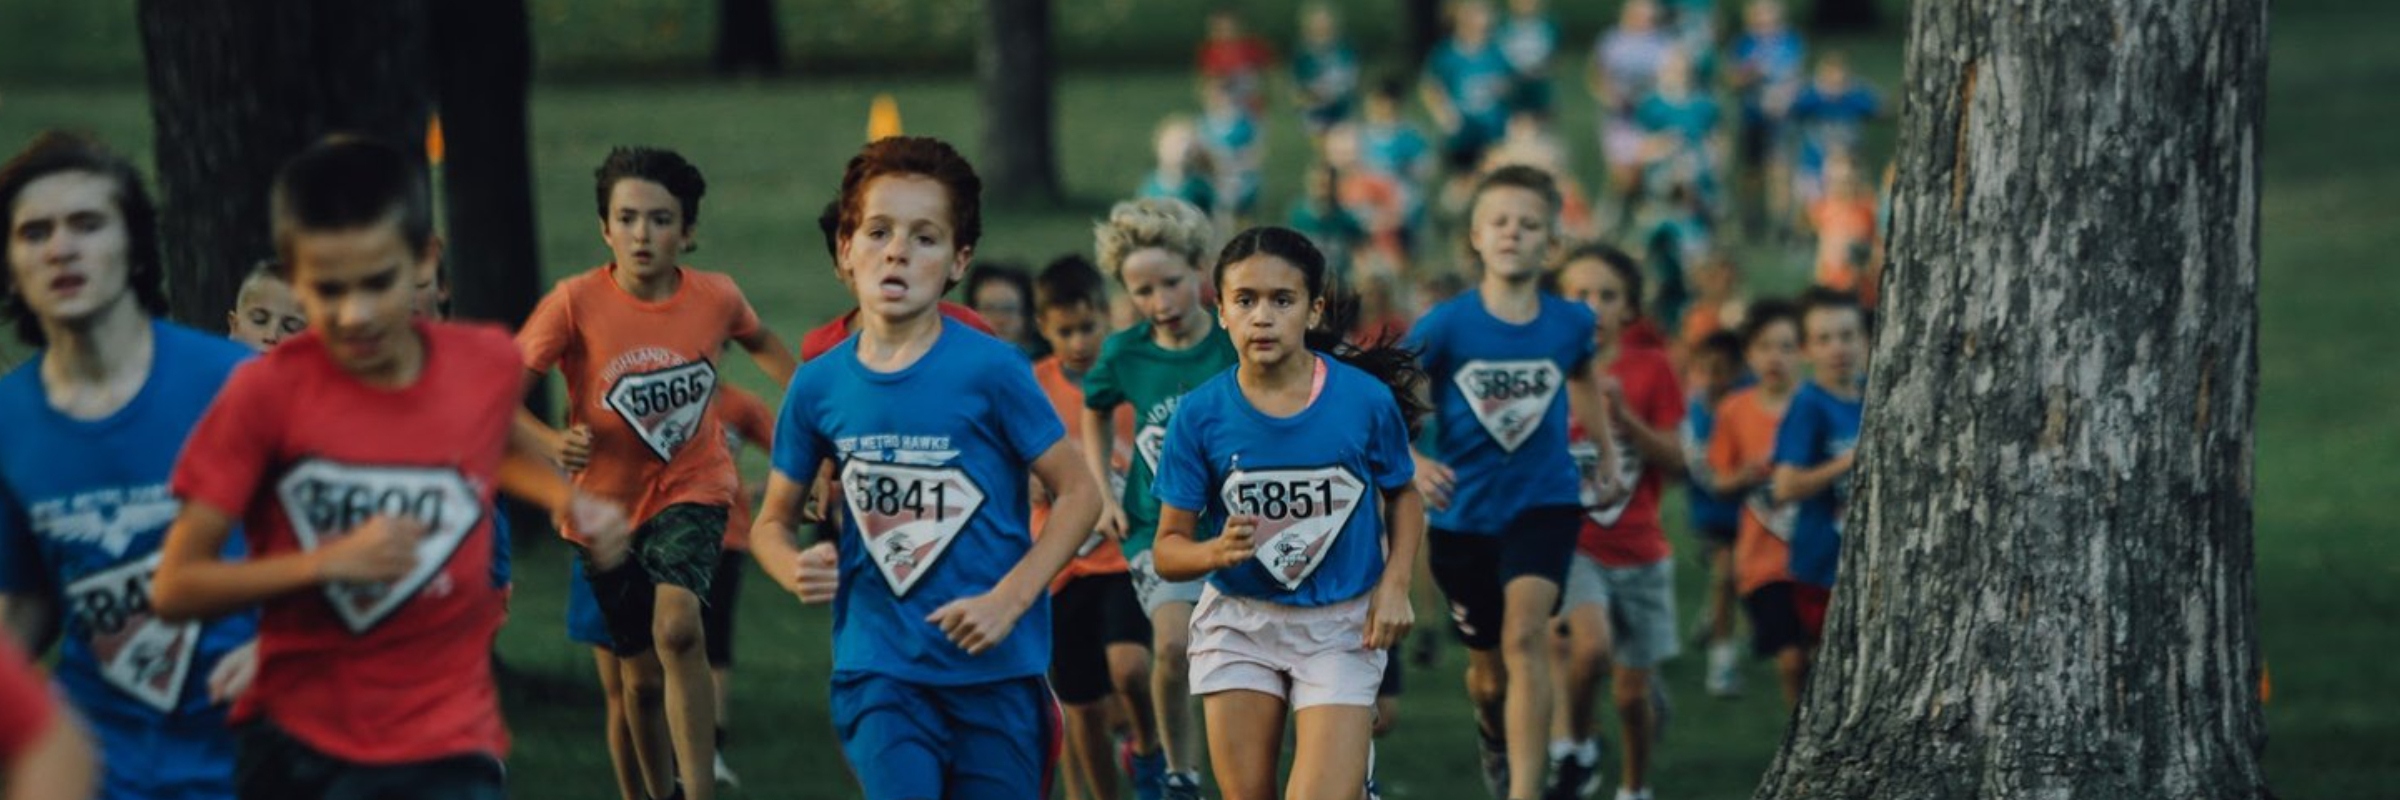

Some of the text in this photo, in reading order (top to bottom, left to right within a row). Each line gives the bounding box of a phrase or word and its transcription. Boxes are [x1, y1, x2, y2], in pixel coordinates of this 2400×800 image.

[628, 368, 710, 417] 5665
[859, 434, 900, 450] METRO
[901, 435, 950, 450] HAWKS
[855, 473, 945, 523] 5841
[1237, 478, 1333, 520] 5851
